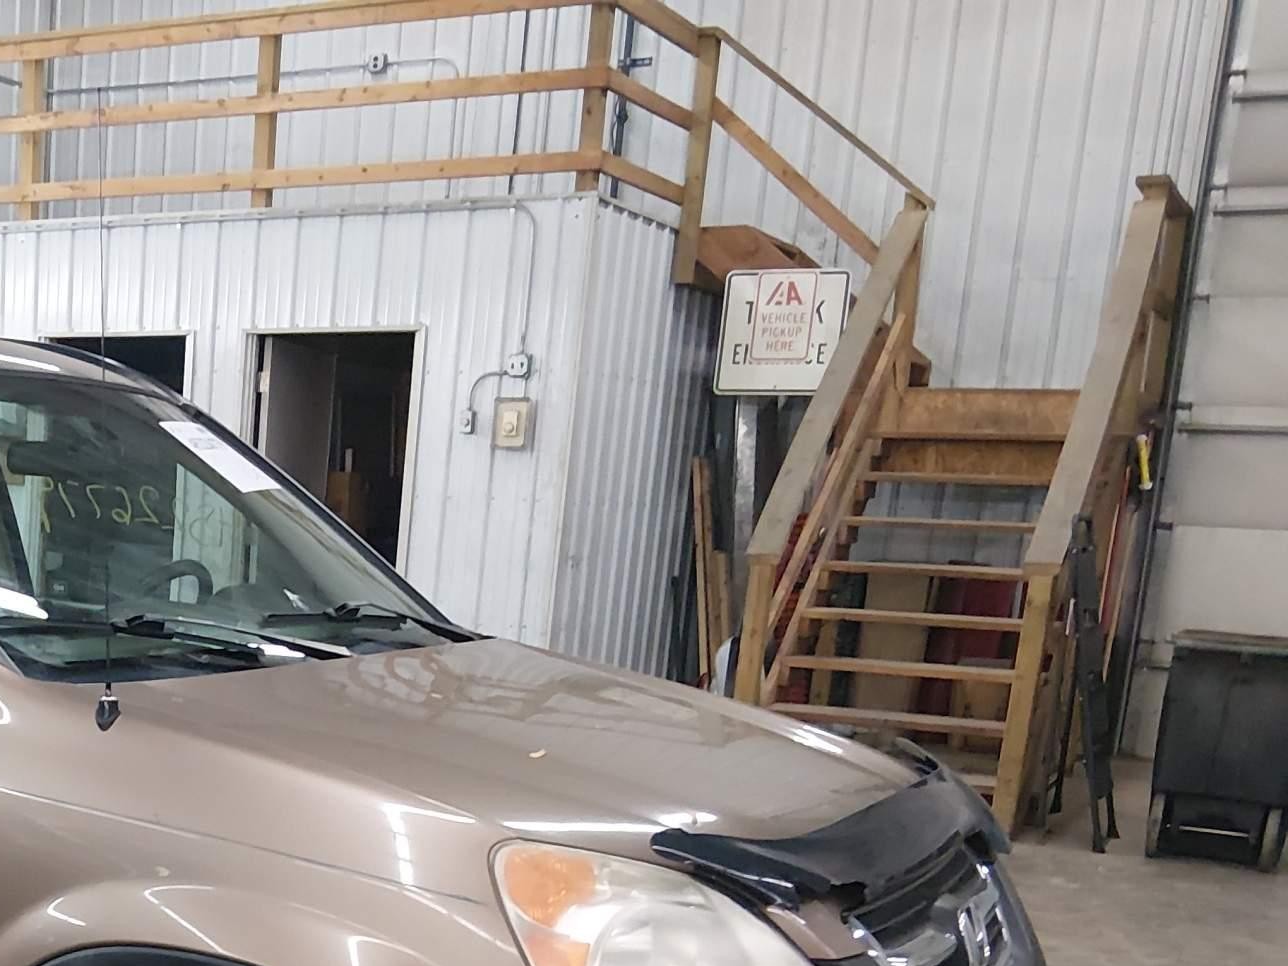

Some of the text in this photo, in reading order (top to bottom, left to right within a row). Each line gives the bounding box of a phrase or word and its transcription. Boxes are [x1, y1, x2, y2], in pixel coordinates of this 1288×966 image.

[761, 312, 808, 324] VEHICLE
[760, 327, 803, 338] PICKUP
[765, 340, 795, 353] HERE
